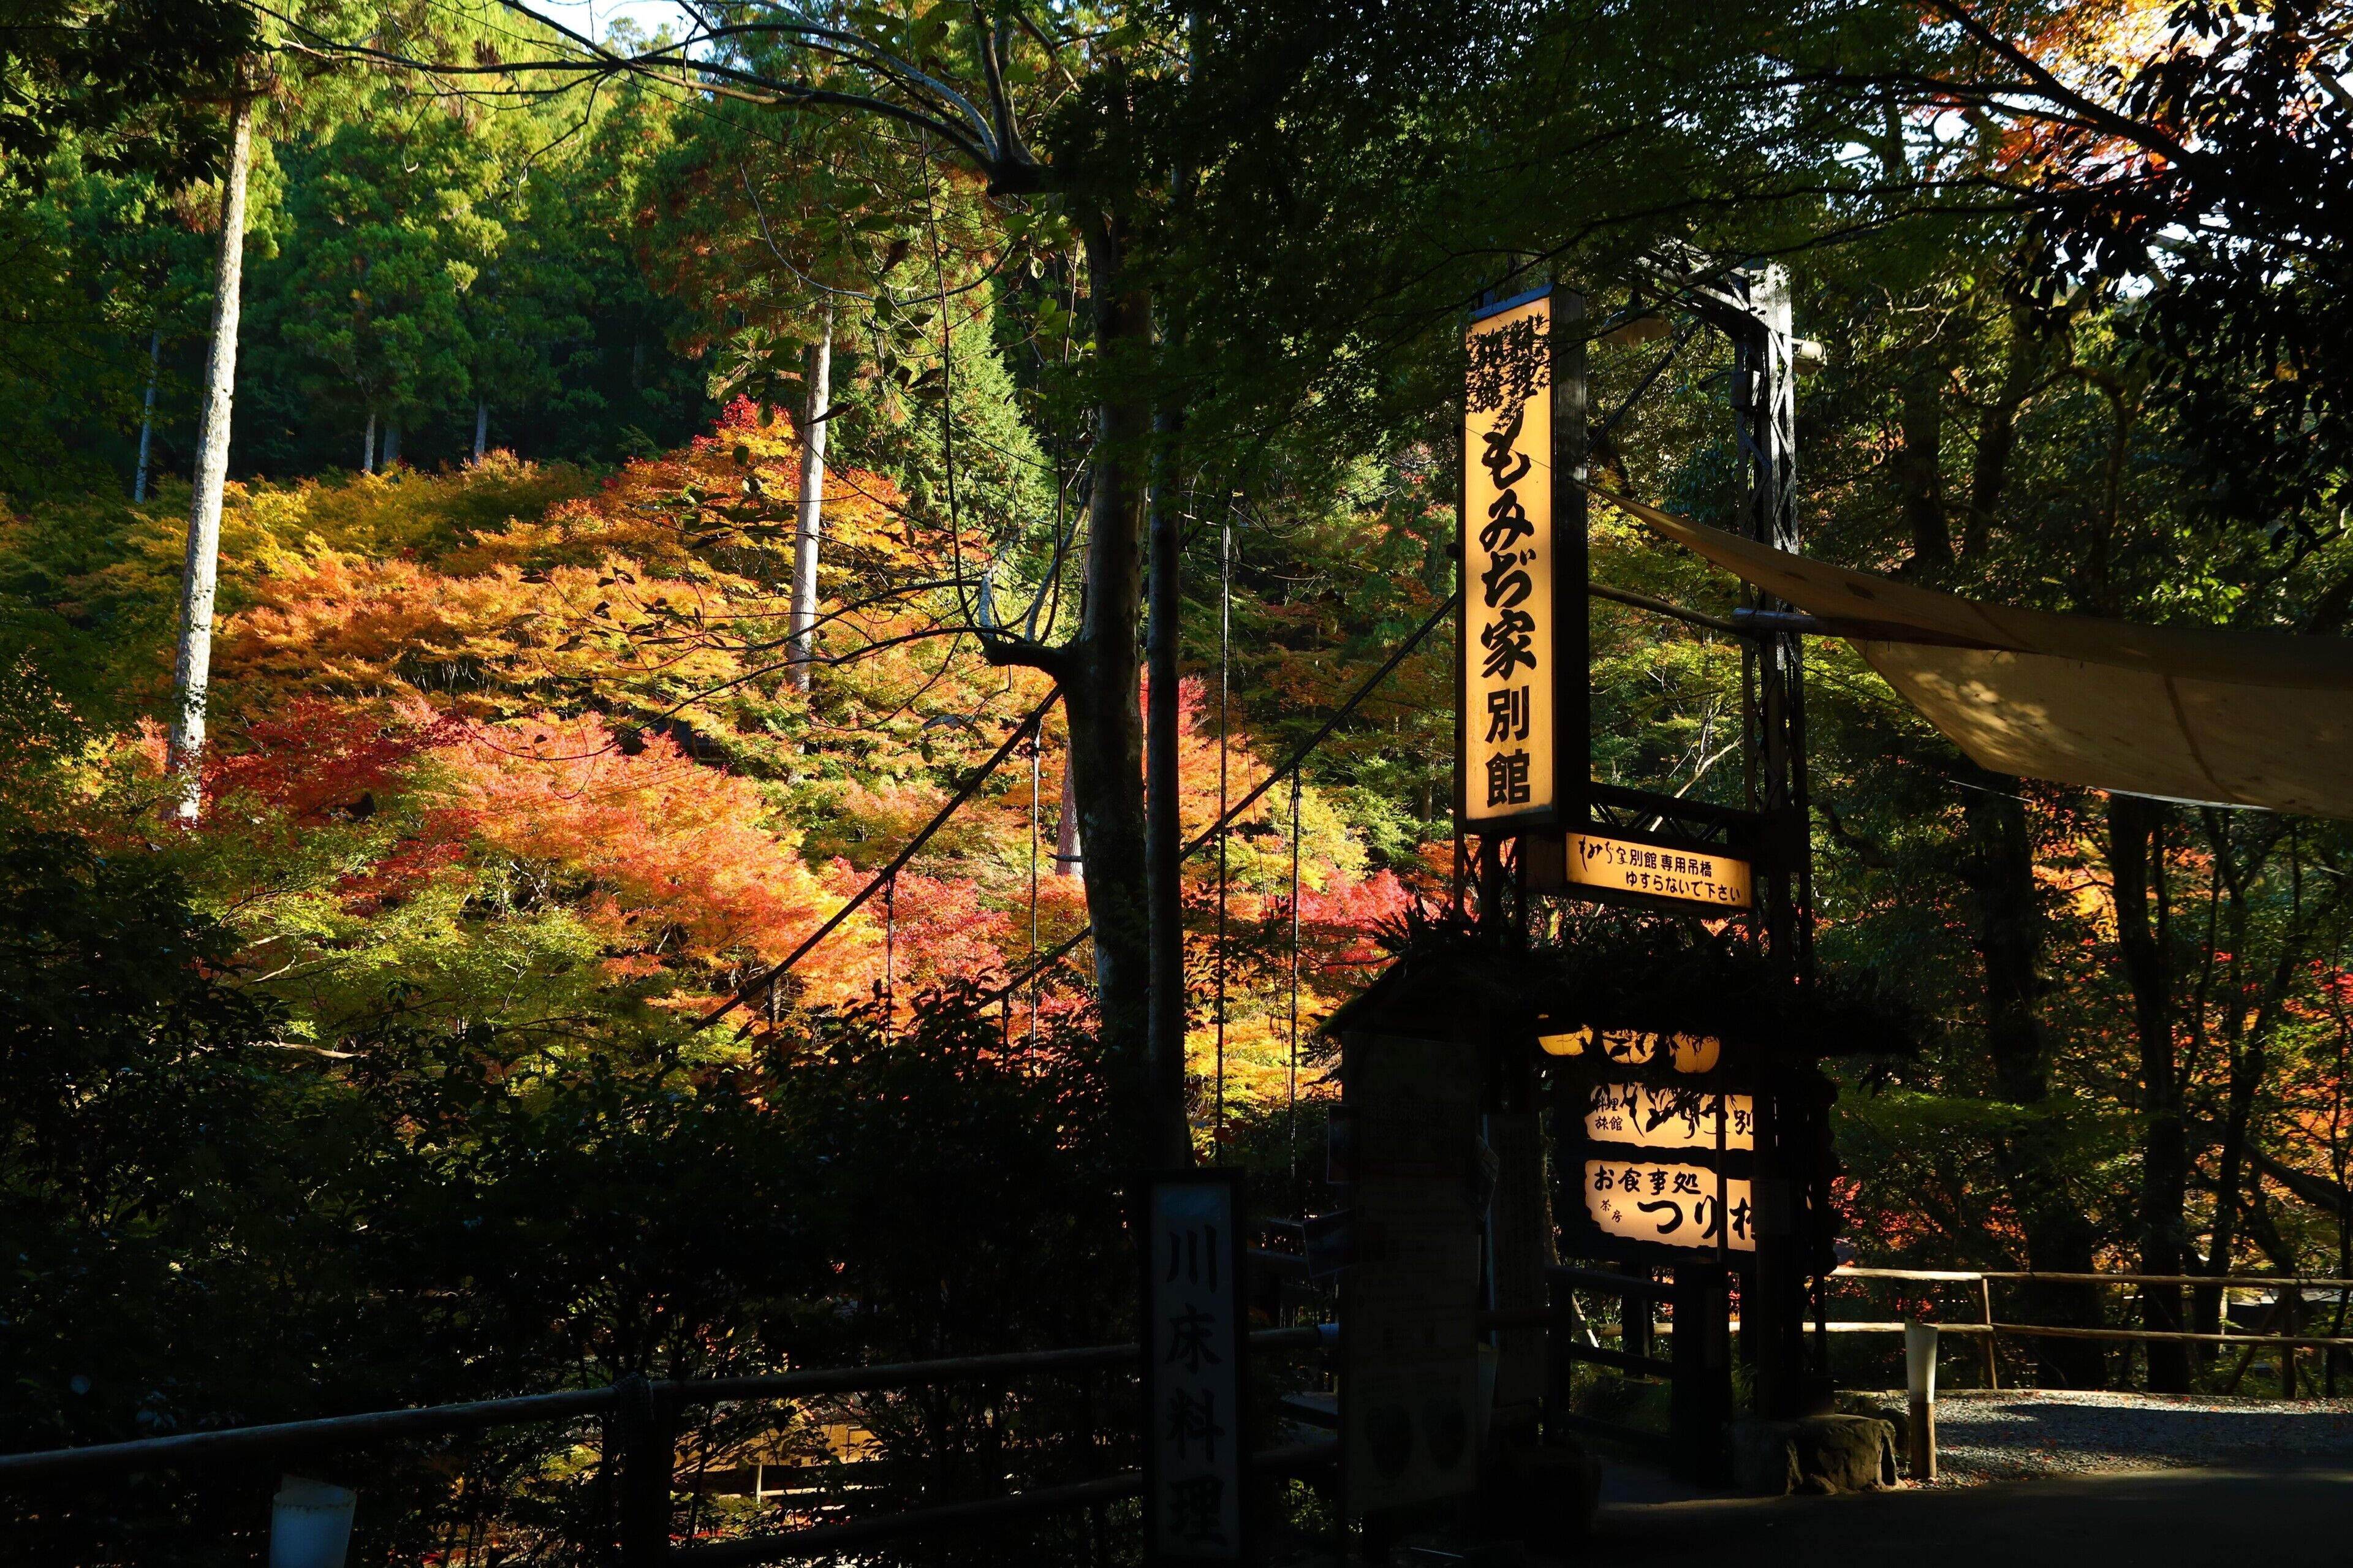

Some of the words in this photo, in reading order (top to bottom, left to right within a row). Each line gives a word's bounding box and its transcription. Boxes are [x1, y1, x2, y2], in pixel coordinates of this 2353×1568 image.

[1479, 402, 1537, 808] もみぢ家別館
[1626, 871, 1741, 902] ゆすらないで下さい
[1595, 1115, 1623, 1131] 旅館
[1594, 1165, 1702, 1195] お食事処
[1165, 1224, 1227, 1547] 川床料理
